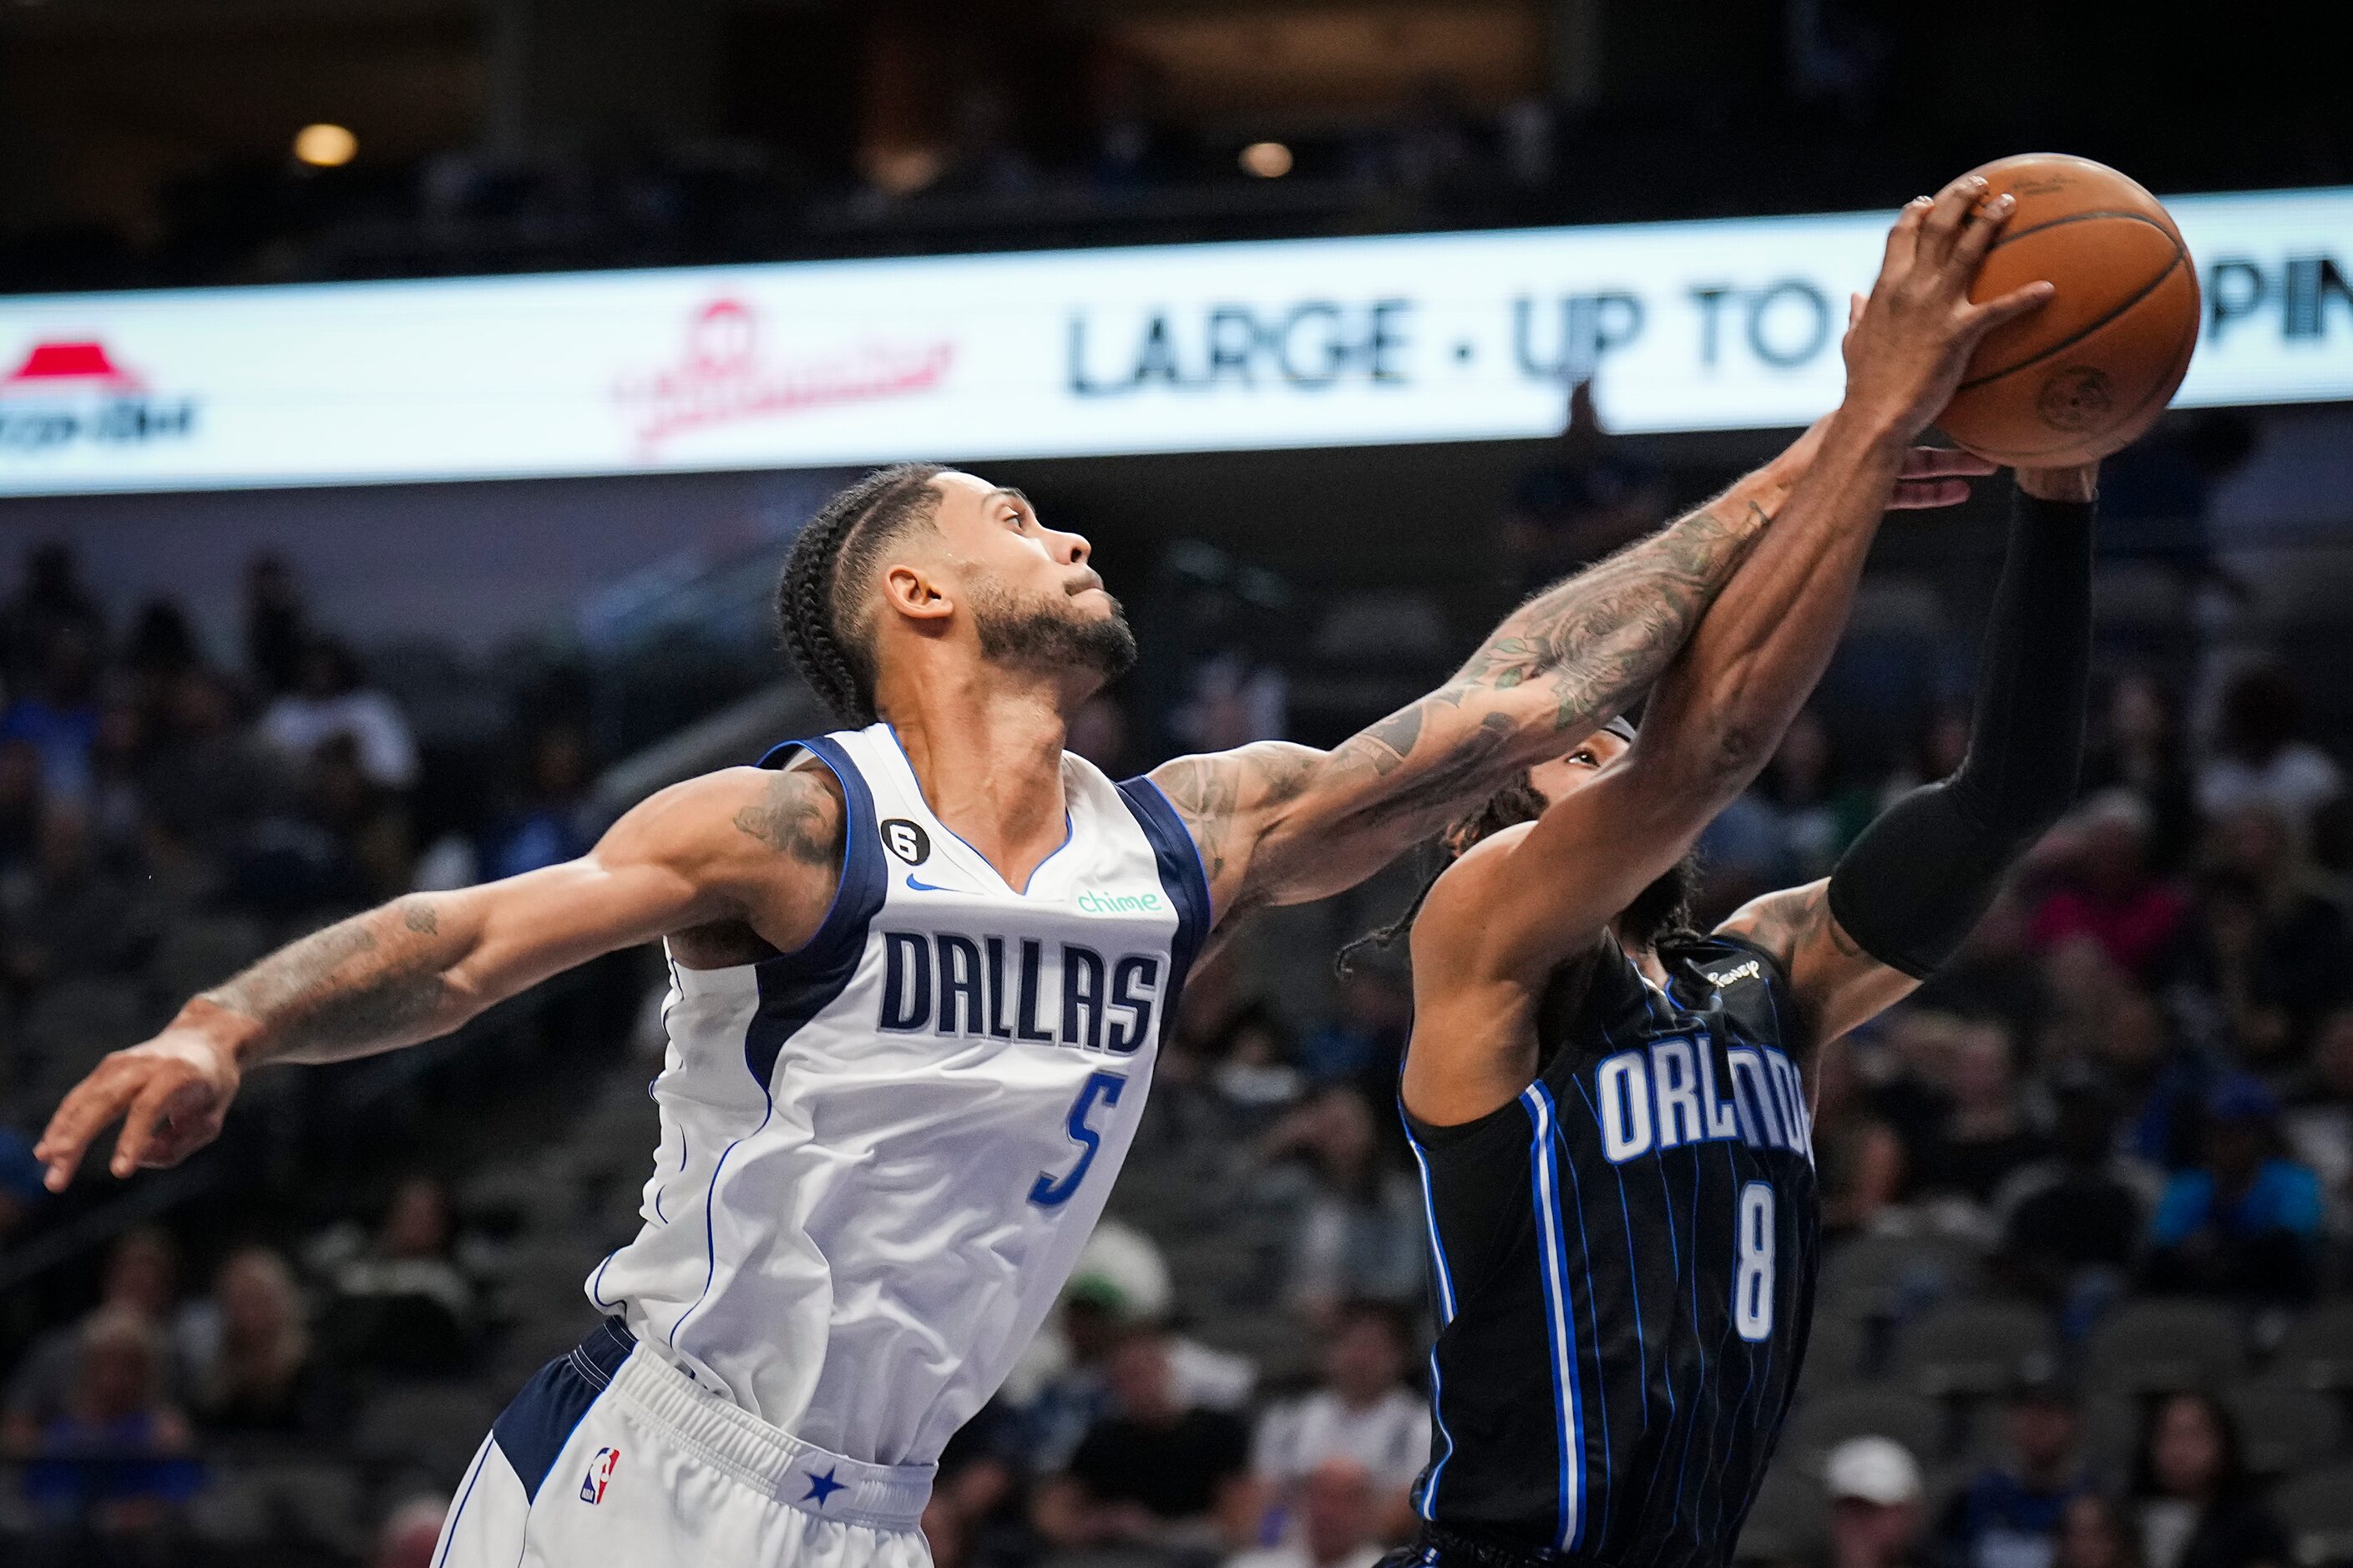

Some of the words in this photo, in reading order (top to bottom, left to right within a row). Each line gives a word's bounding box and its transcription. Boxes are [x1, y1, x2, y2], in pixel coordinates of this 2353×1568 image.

[1067, 297, 1415, 397] LARGE
[1510, 288, 1645, 380] UP
[1682, 279, 1832, 372] TO
[890, 822, 918, 862] 6
[1079, 891, 1162, 914] chime
[878, 931, 1171, 1057] DALLAS
[1708, 960, 1760, 988] isney
[1028, 1071, 1129, 1210] 5
[1734, 1181, 1774, 1342] 8
